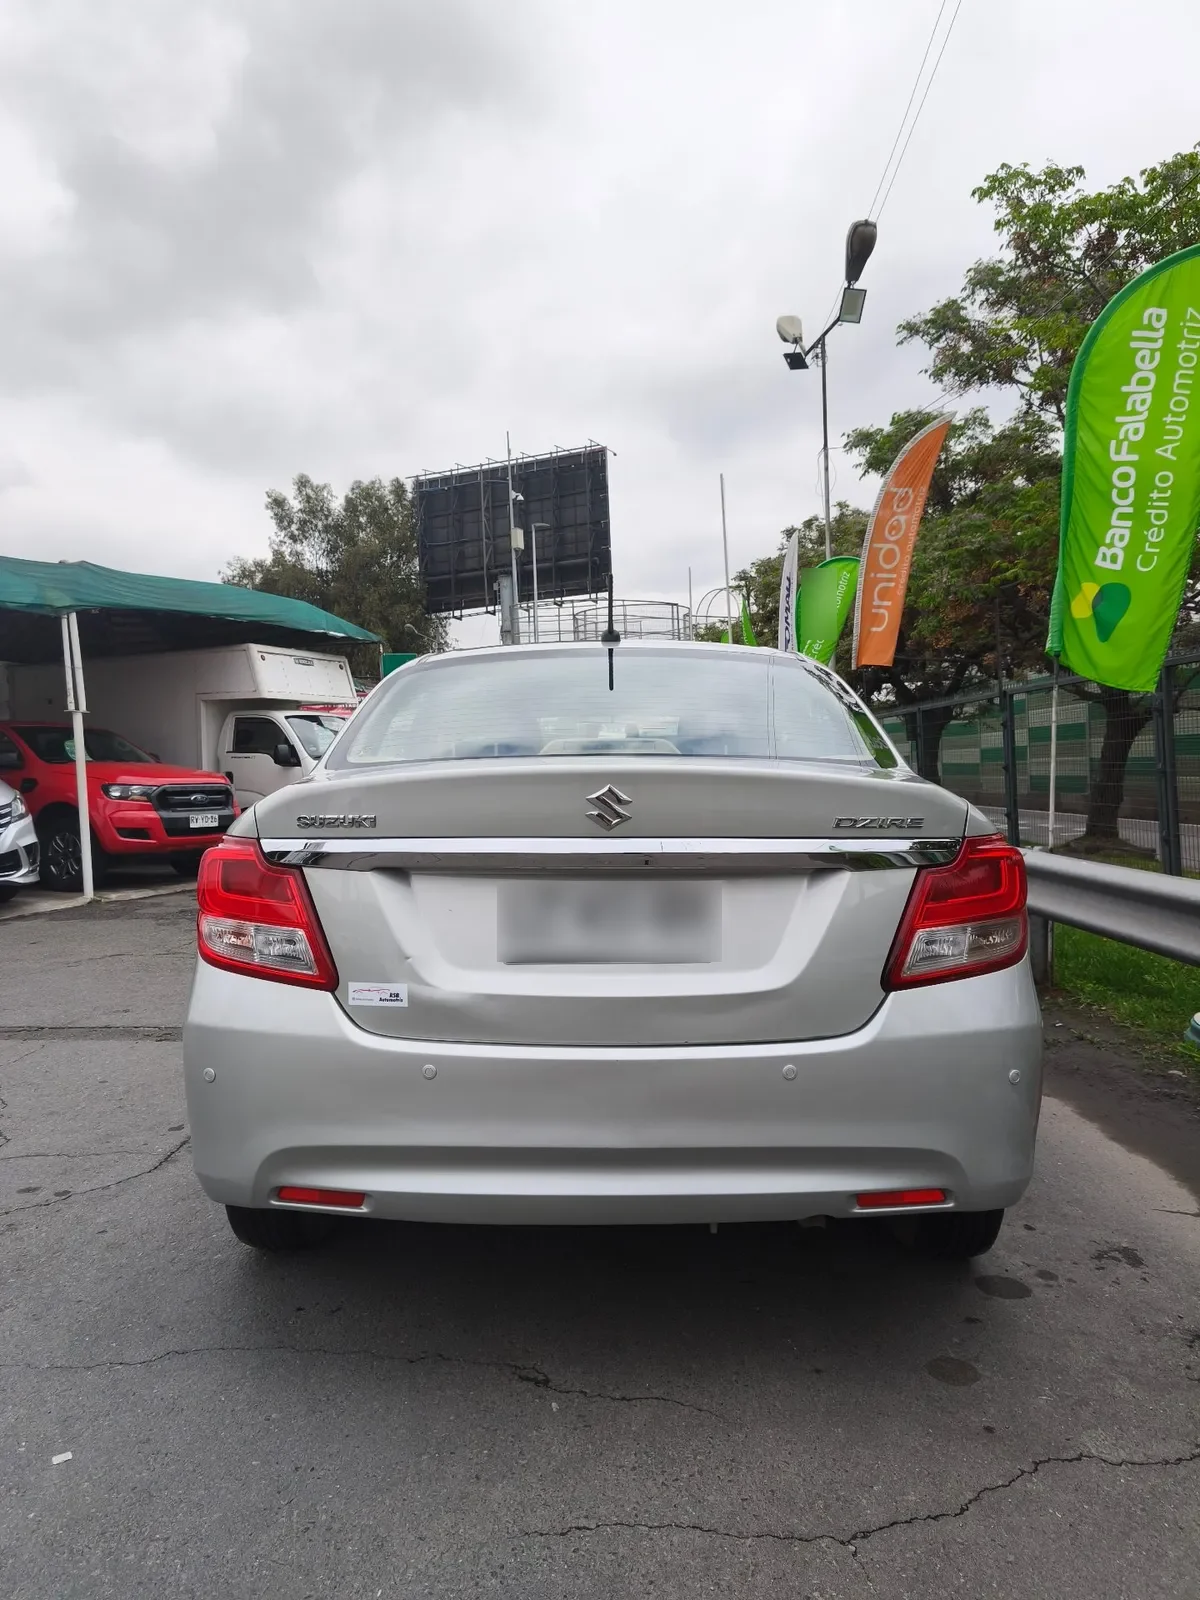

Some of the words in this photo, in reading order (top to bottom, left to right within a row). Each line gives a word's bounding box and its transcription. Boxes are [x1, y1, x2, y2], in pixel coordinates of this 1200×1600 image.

[1094, 306, 1168, 571] BancoFalabella
[1136, 470, 1174, 572] Crédito
[1155, 305, 1200, 460] Automotriz
[870, 486, 913, 632] unidad
[296, 814, 377, 829] SUZUKI
[832, 816, 925, 829] DZIRE
